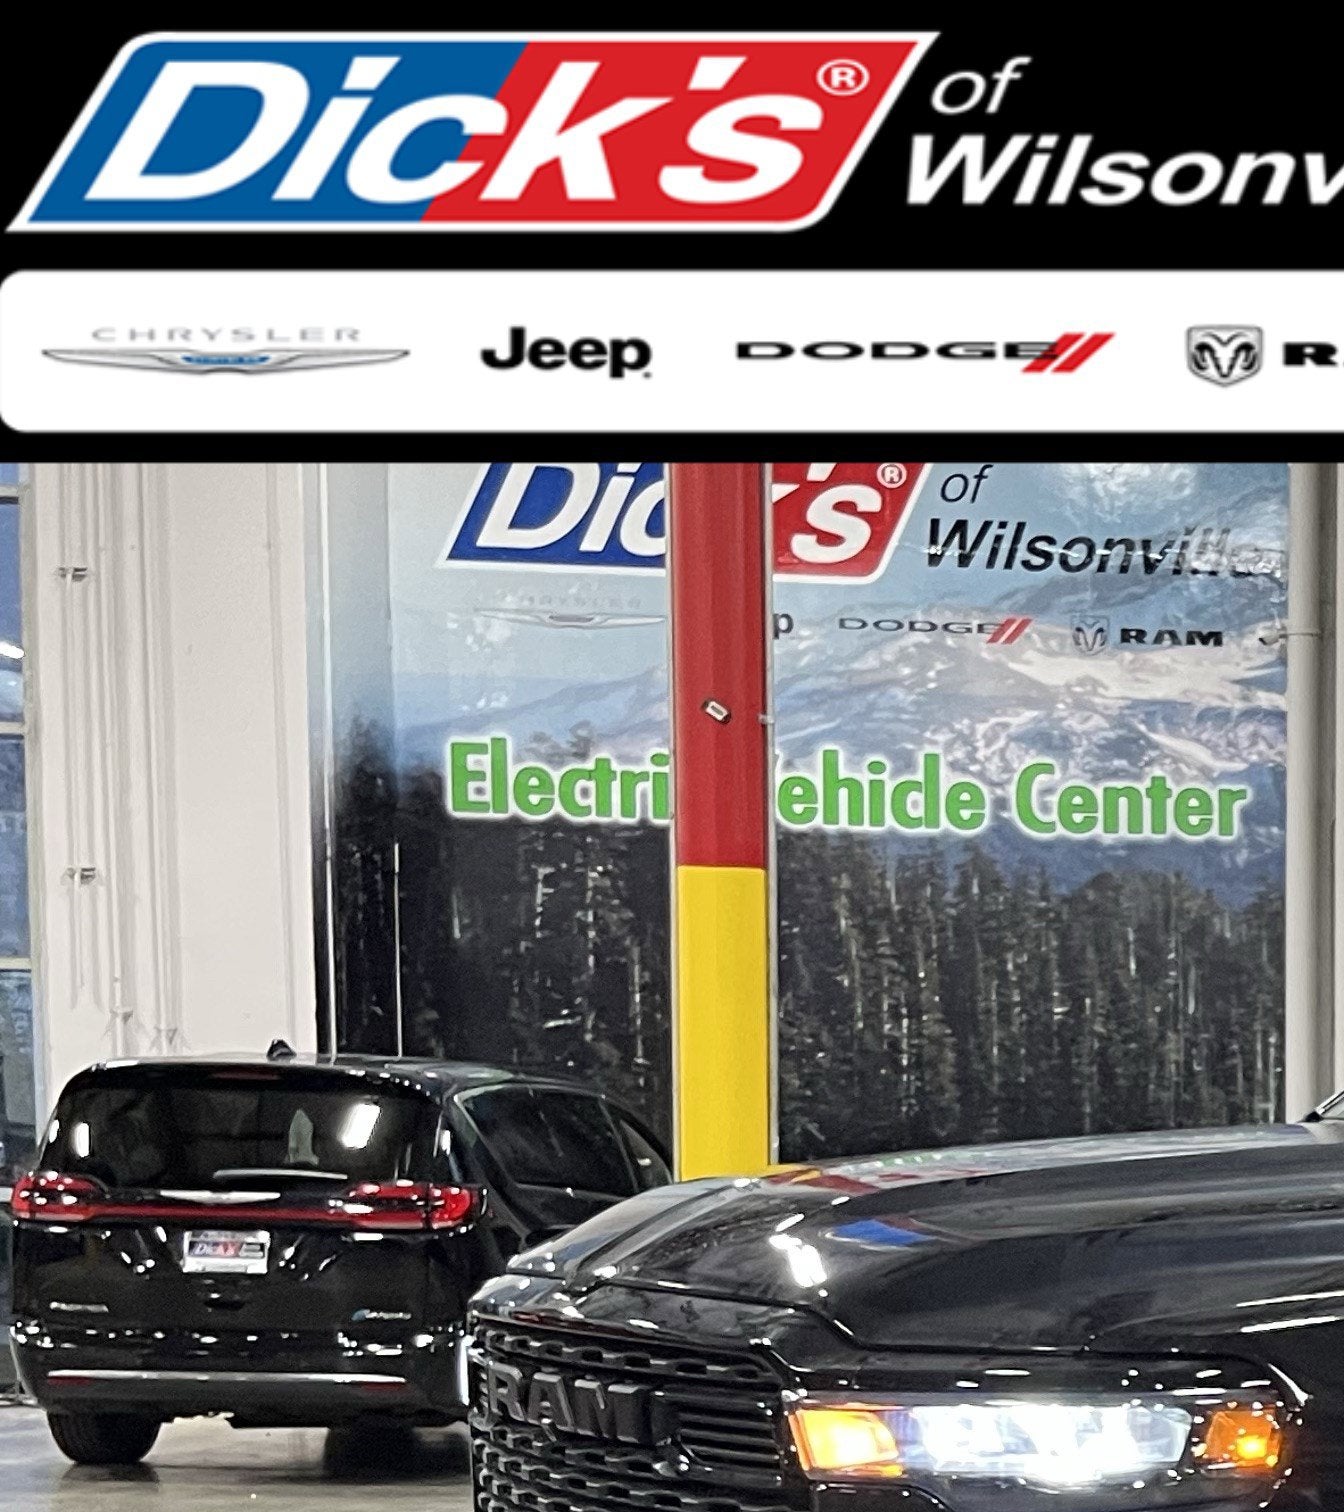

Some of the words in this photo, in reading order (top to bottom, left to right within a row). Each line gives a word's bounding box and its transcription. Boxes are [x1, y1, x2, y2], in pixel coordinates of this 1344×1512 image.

[940, 464, 993, 504] of
[838, 617, 1004, 635] DODGE
[1119, 627, 1223, 648] RAM
[450, 736, 671, 821] Electri
[776, 748, 988, 832] ehicle
[1015, 761, 1248, 837] Center
[488, 1361, 647, 1444] RAM
